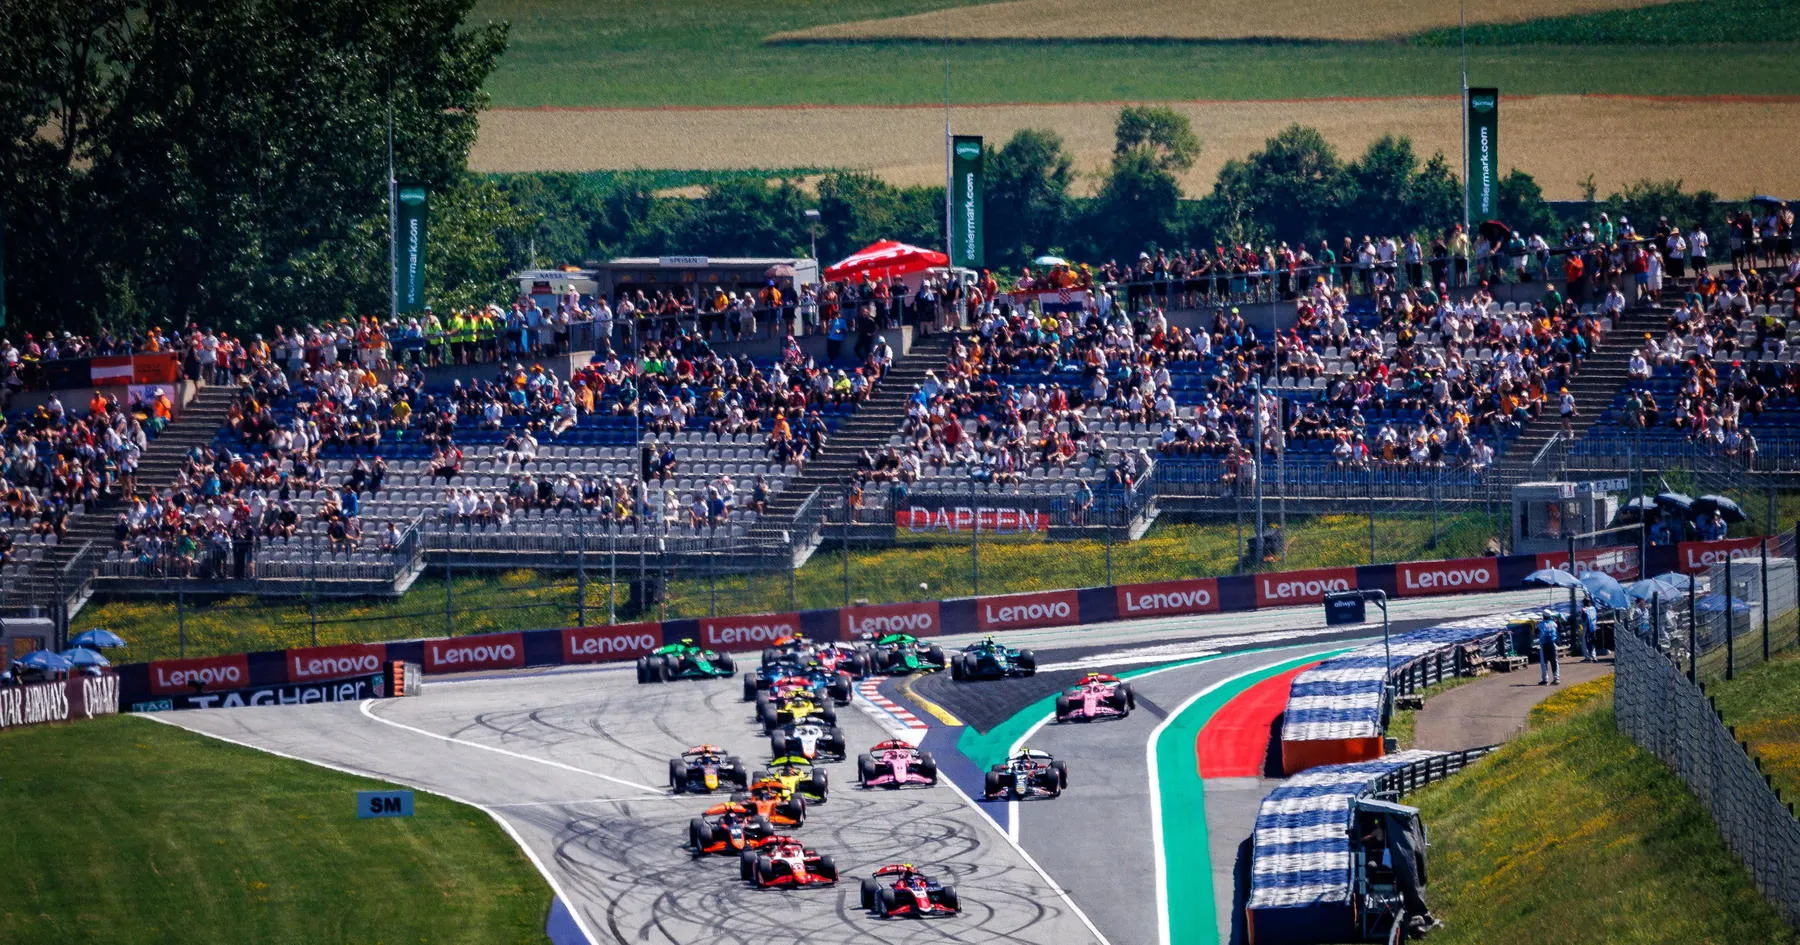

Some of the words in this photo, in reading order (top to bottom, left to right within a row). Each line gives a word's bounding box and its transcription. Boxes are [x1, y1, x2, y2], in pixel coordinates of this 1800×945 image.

[1480, 126, 1490, 213] steiermark.com
[965, 172, 976, 260] steiermark.com
[1264, 578, 1349, 599] Lenovo
[1405, 568, 1490, 589] Lenovo
[1126, 589, 1211, 611] Lenovo
[848, 612, 932, 634] Lenovo
[986, 601, 1071, 624] Lenovo
[570, 634, 656, 655] Lenovo
[708, 623, 793, 645] Lenovo
[295, 654, 379, 677] Lenovo
[432, 644, 516, 666] Lenovo
[157, 665, 241, 687] Lenovo
[0, 687, 23, 728] TAR
[24, 681, 69, 724] AIRWAYS
[83, 676, 115, 719] QATAR
[138, 702, 169, 712] TAG
[370, 797, 402, 813] SM
